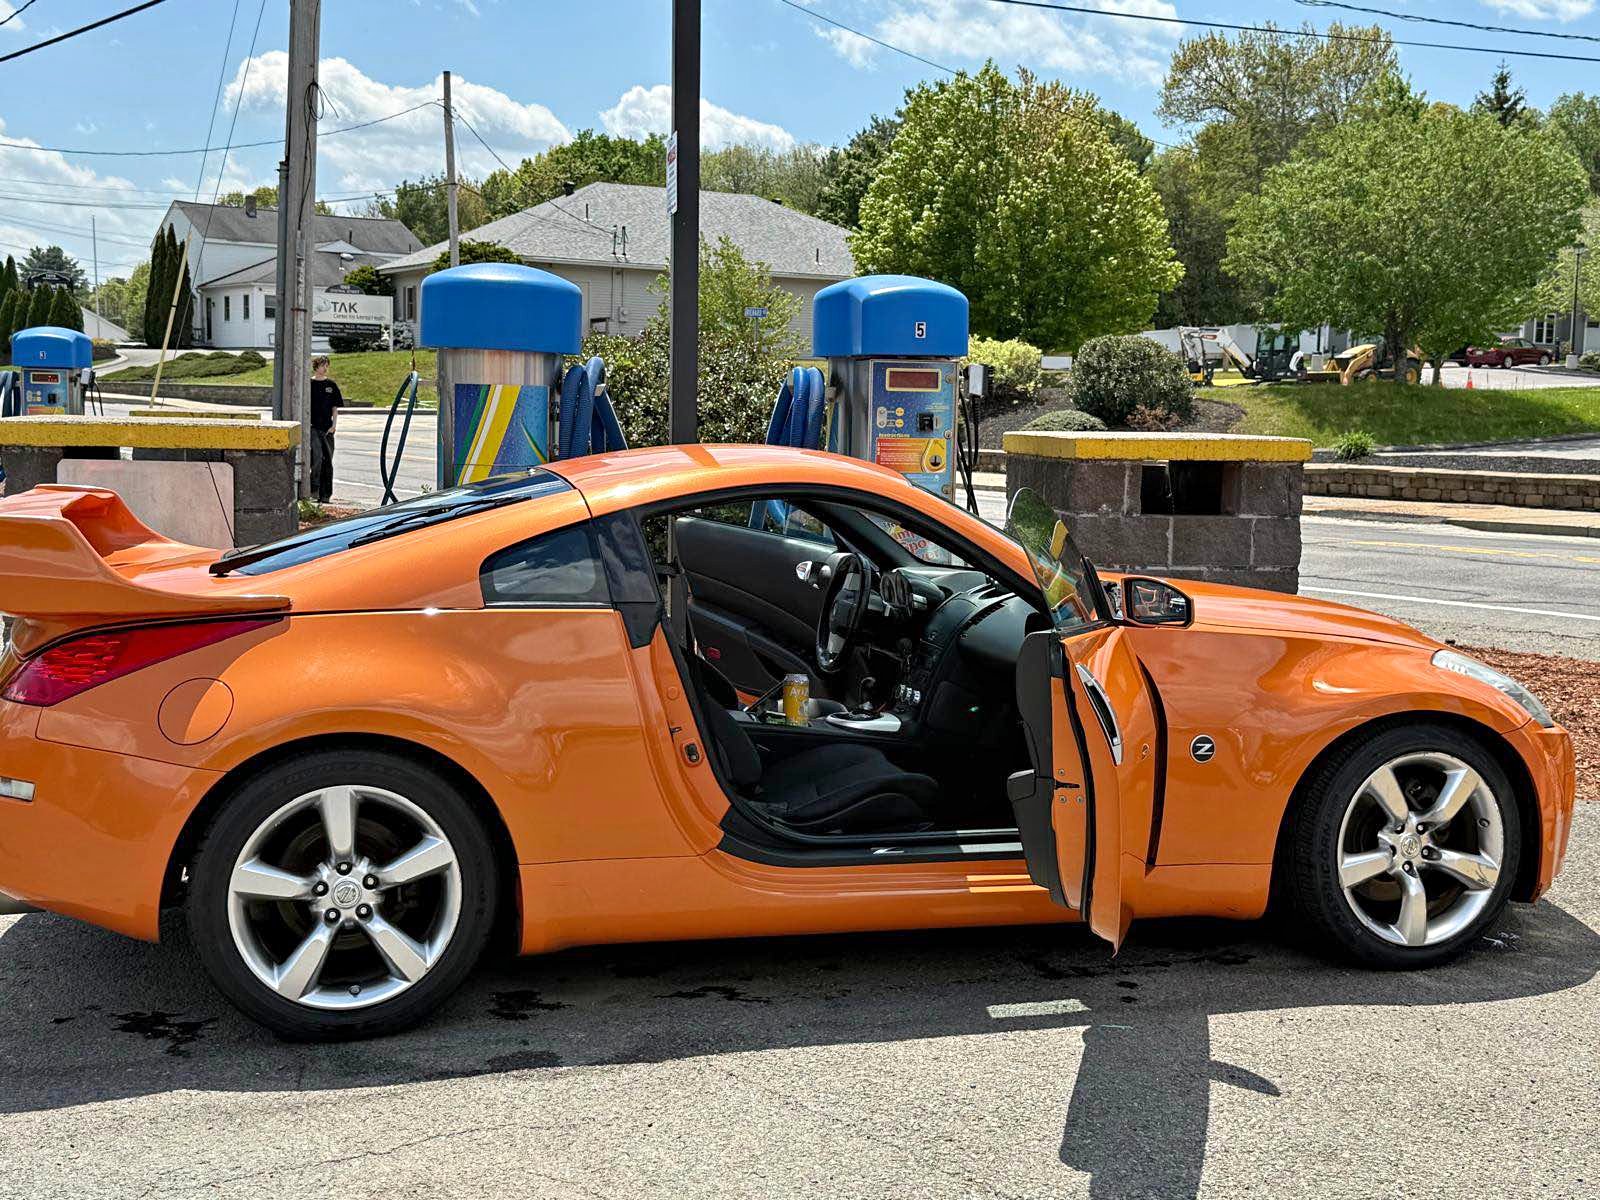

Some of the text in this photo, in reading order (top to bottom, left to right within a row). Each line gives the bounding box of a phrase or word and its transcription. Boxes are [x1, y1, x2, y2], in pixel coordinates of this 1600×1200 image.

[331, 301, 358, 313] TAK
[917, 323, 925, 338] 5
[1194, 743, 1214, 755] Z
